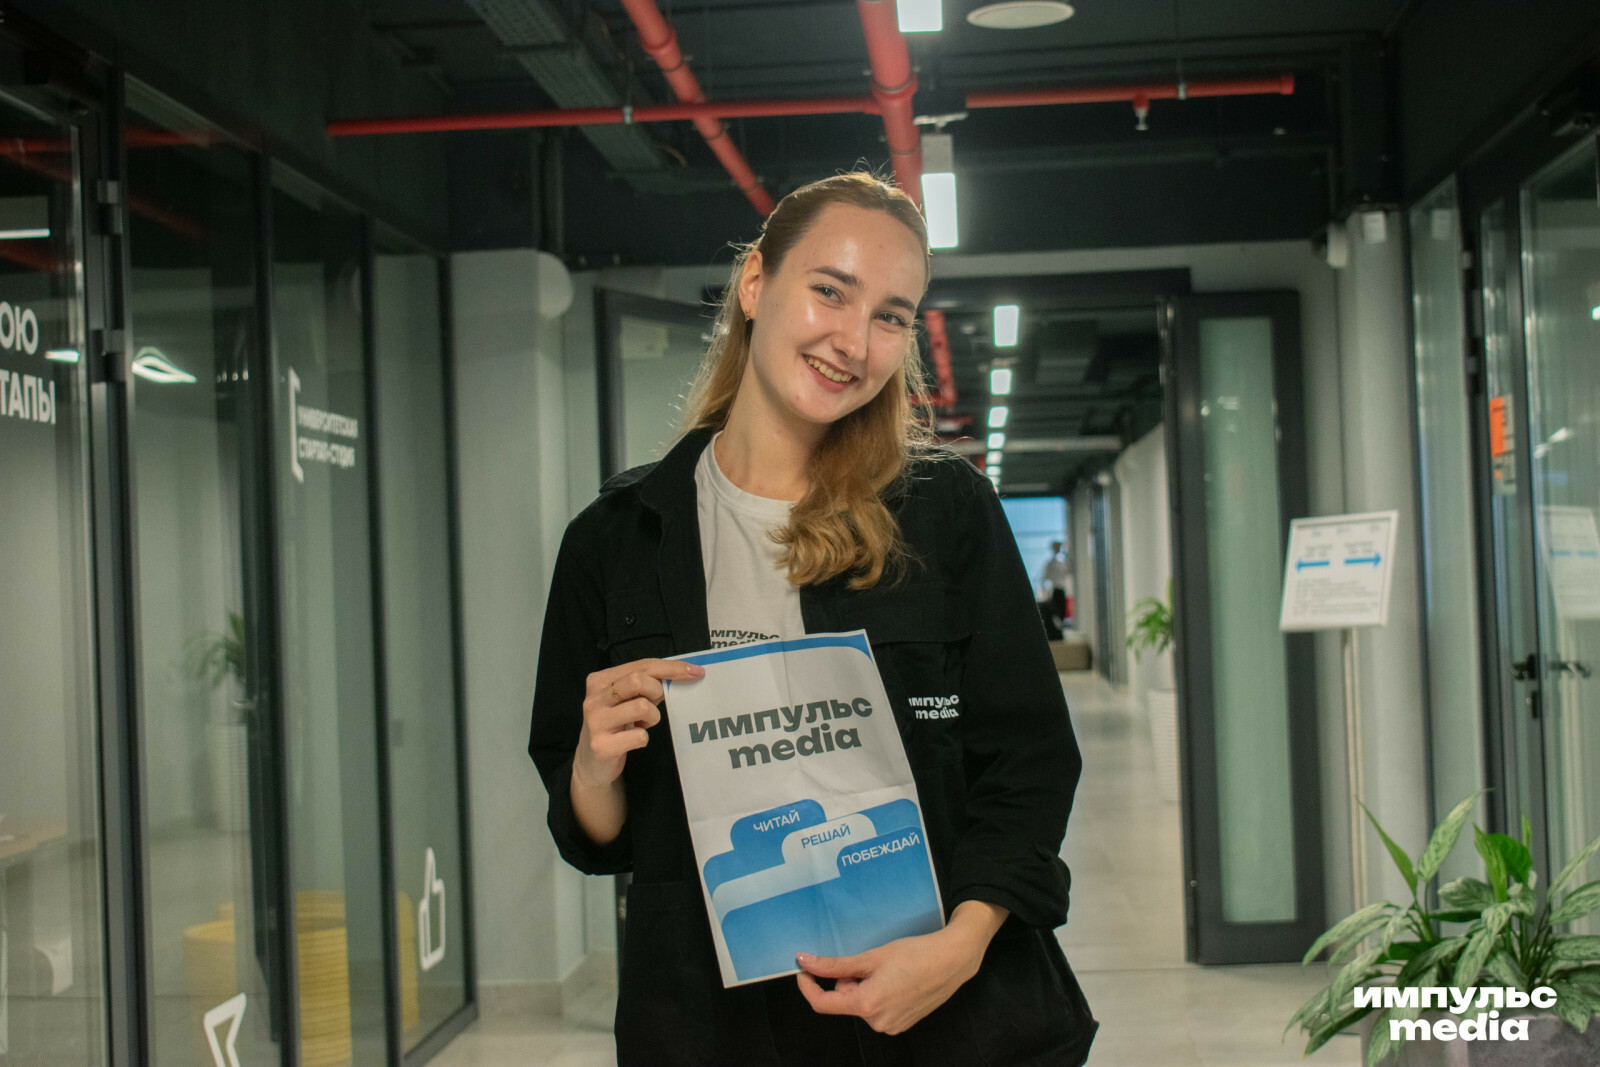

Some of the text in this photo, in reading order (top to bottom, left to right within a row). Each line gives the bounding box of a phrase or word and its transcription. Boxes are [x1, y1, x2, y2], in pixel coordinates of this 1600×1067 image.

[0, 368, 56, 425] ТАПЫ
[688, 697, 873, 744] импульс
[915, 706, 960, 720] media
[728, 723, 862, 769] media
[753, 809, 801, 833] ЧИТАЙ
[801, 823, 851, 849] РЕШАЙ
[841, 831, 921, 867] ПОБЕЖДАЙ
